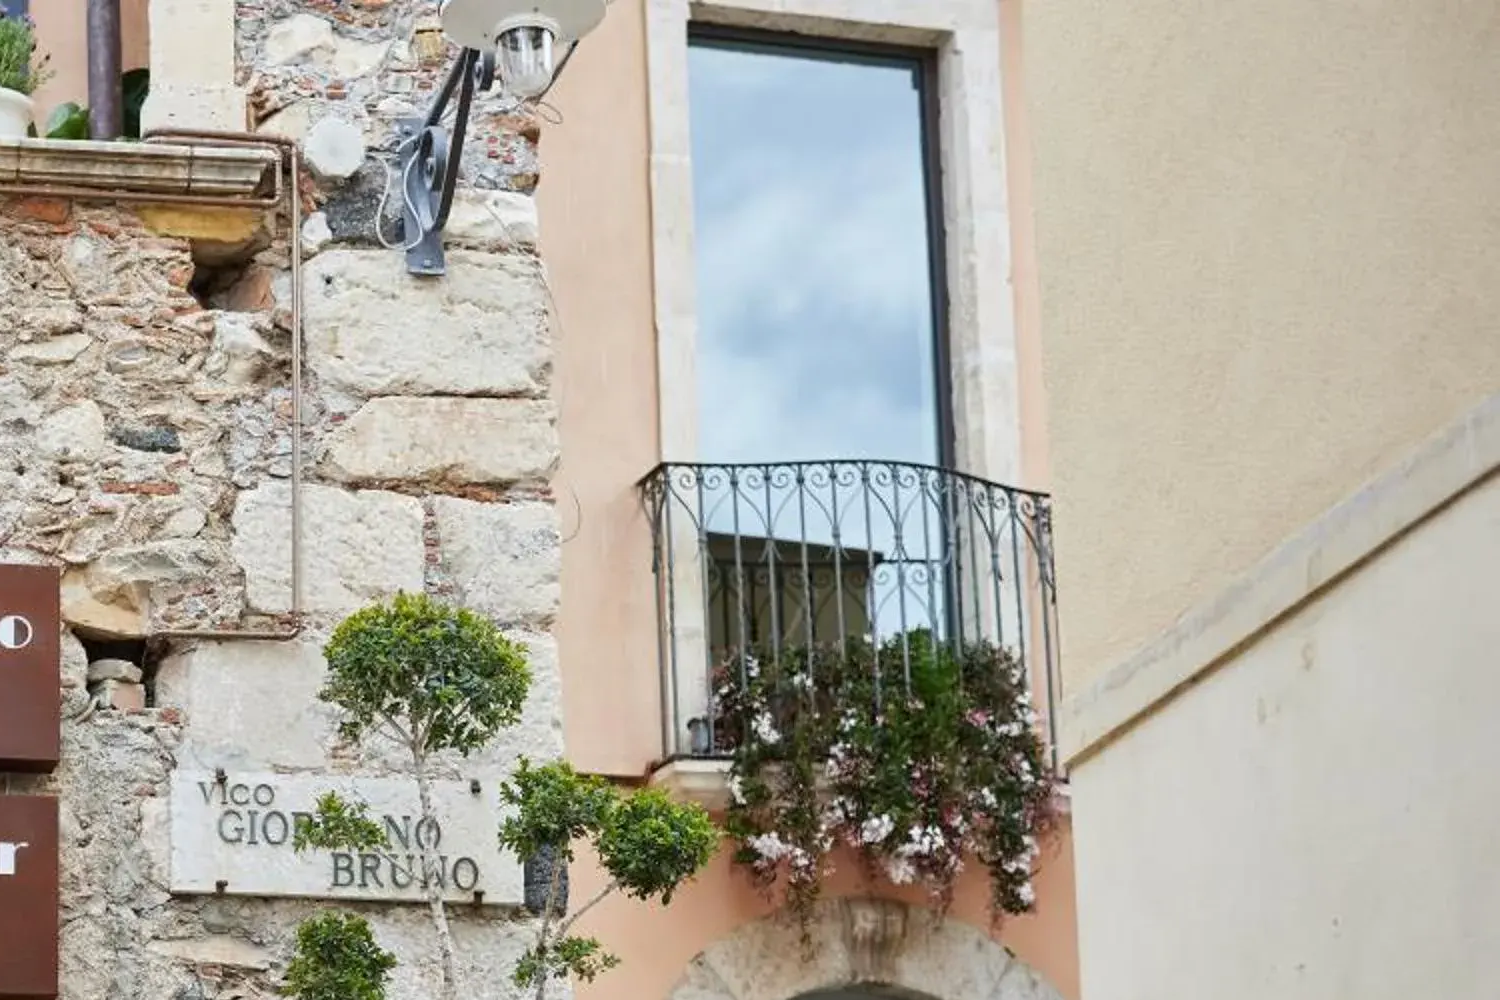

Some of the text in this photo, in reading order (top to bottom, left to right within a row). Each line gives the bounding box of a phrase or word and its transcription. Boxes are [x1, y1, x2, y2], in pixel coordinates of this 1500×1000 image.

[197, 782, 276, 806] VICO
[218, 809, 441, 850] GIONO
[331, 852, 479, 891] BRUNO
